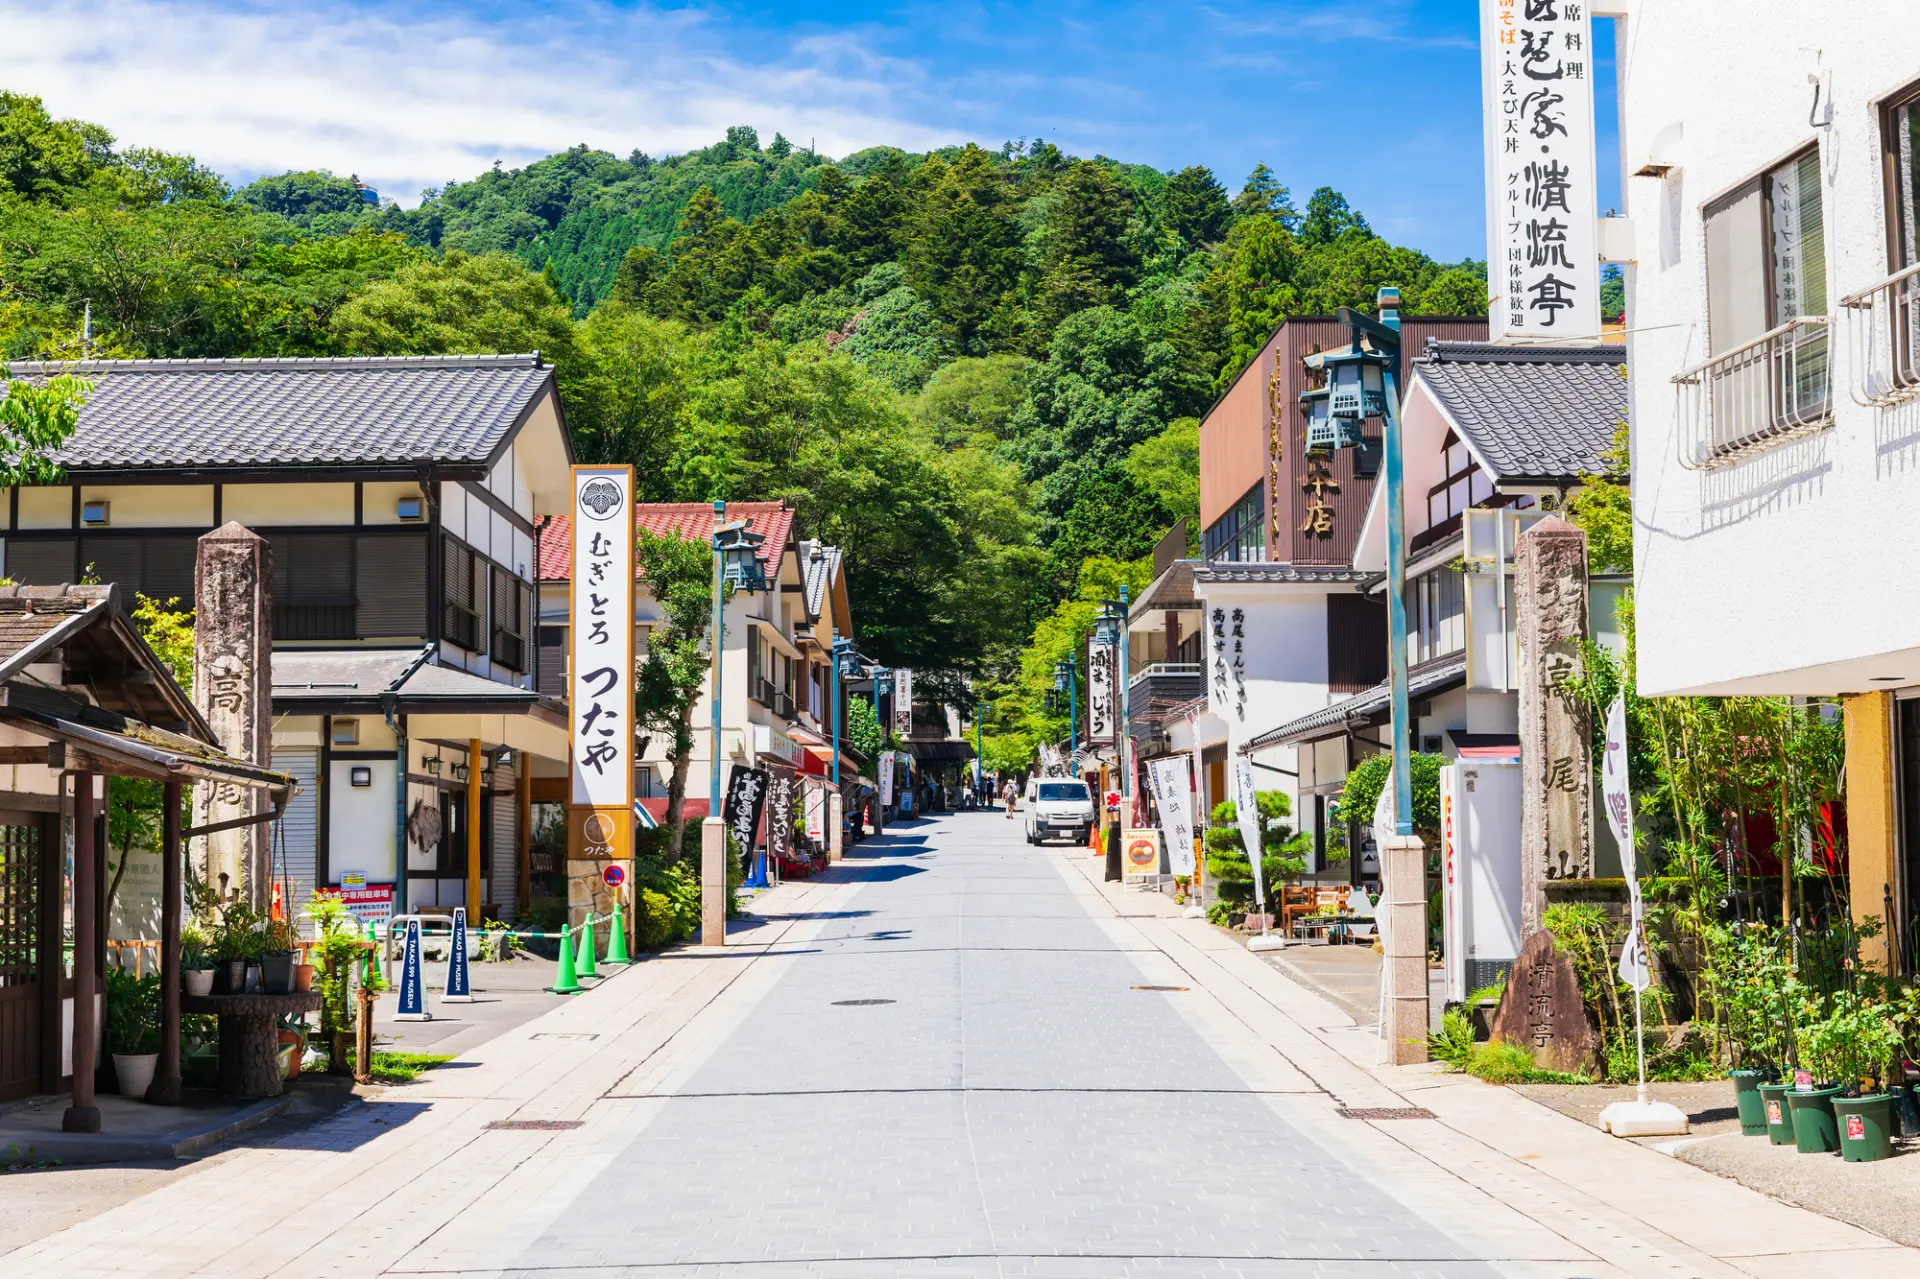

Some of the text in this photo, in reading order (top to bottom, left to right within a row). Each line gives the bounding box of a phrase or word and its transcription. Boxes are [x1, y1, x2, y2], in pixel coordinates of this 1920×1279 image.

[1499, 0, 1524, 328] そば・大えび天丼 グループ・団体様歓迎
[581, 531, 618, 775] むぎとろ つたや
[584, 846, 615, 855] つたや
[408, 939, 416, 965] TAKAO
[1528, 962, 1555, 1047] 清流亭
